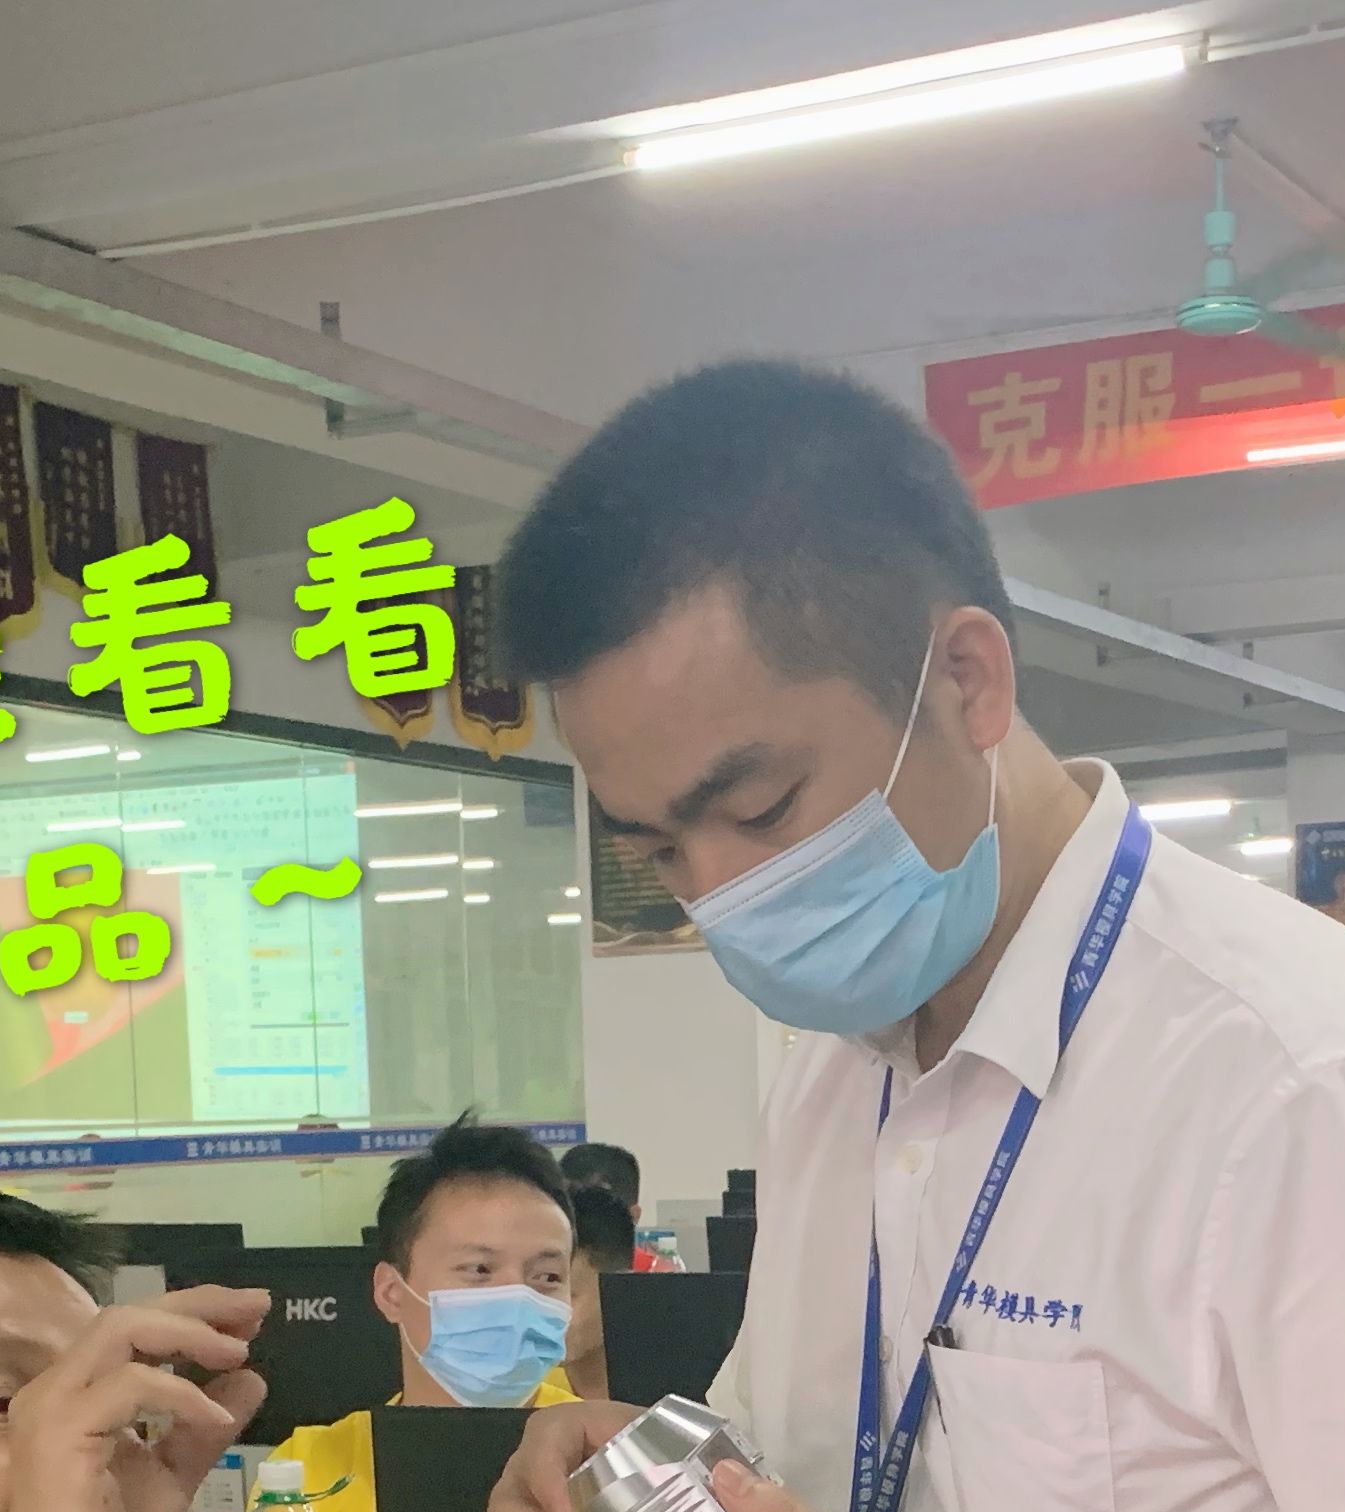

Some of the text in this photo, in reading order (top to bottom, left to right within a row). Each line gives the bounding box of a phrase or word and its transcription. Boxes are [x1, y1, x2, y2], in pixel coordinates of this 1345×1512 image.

[1081, 873, 1130, 967] 青华模具学院
[285, 1296, 338, 1322] HKC
